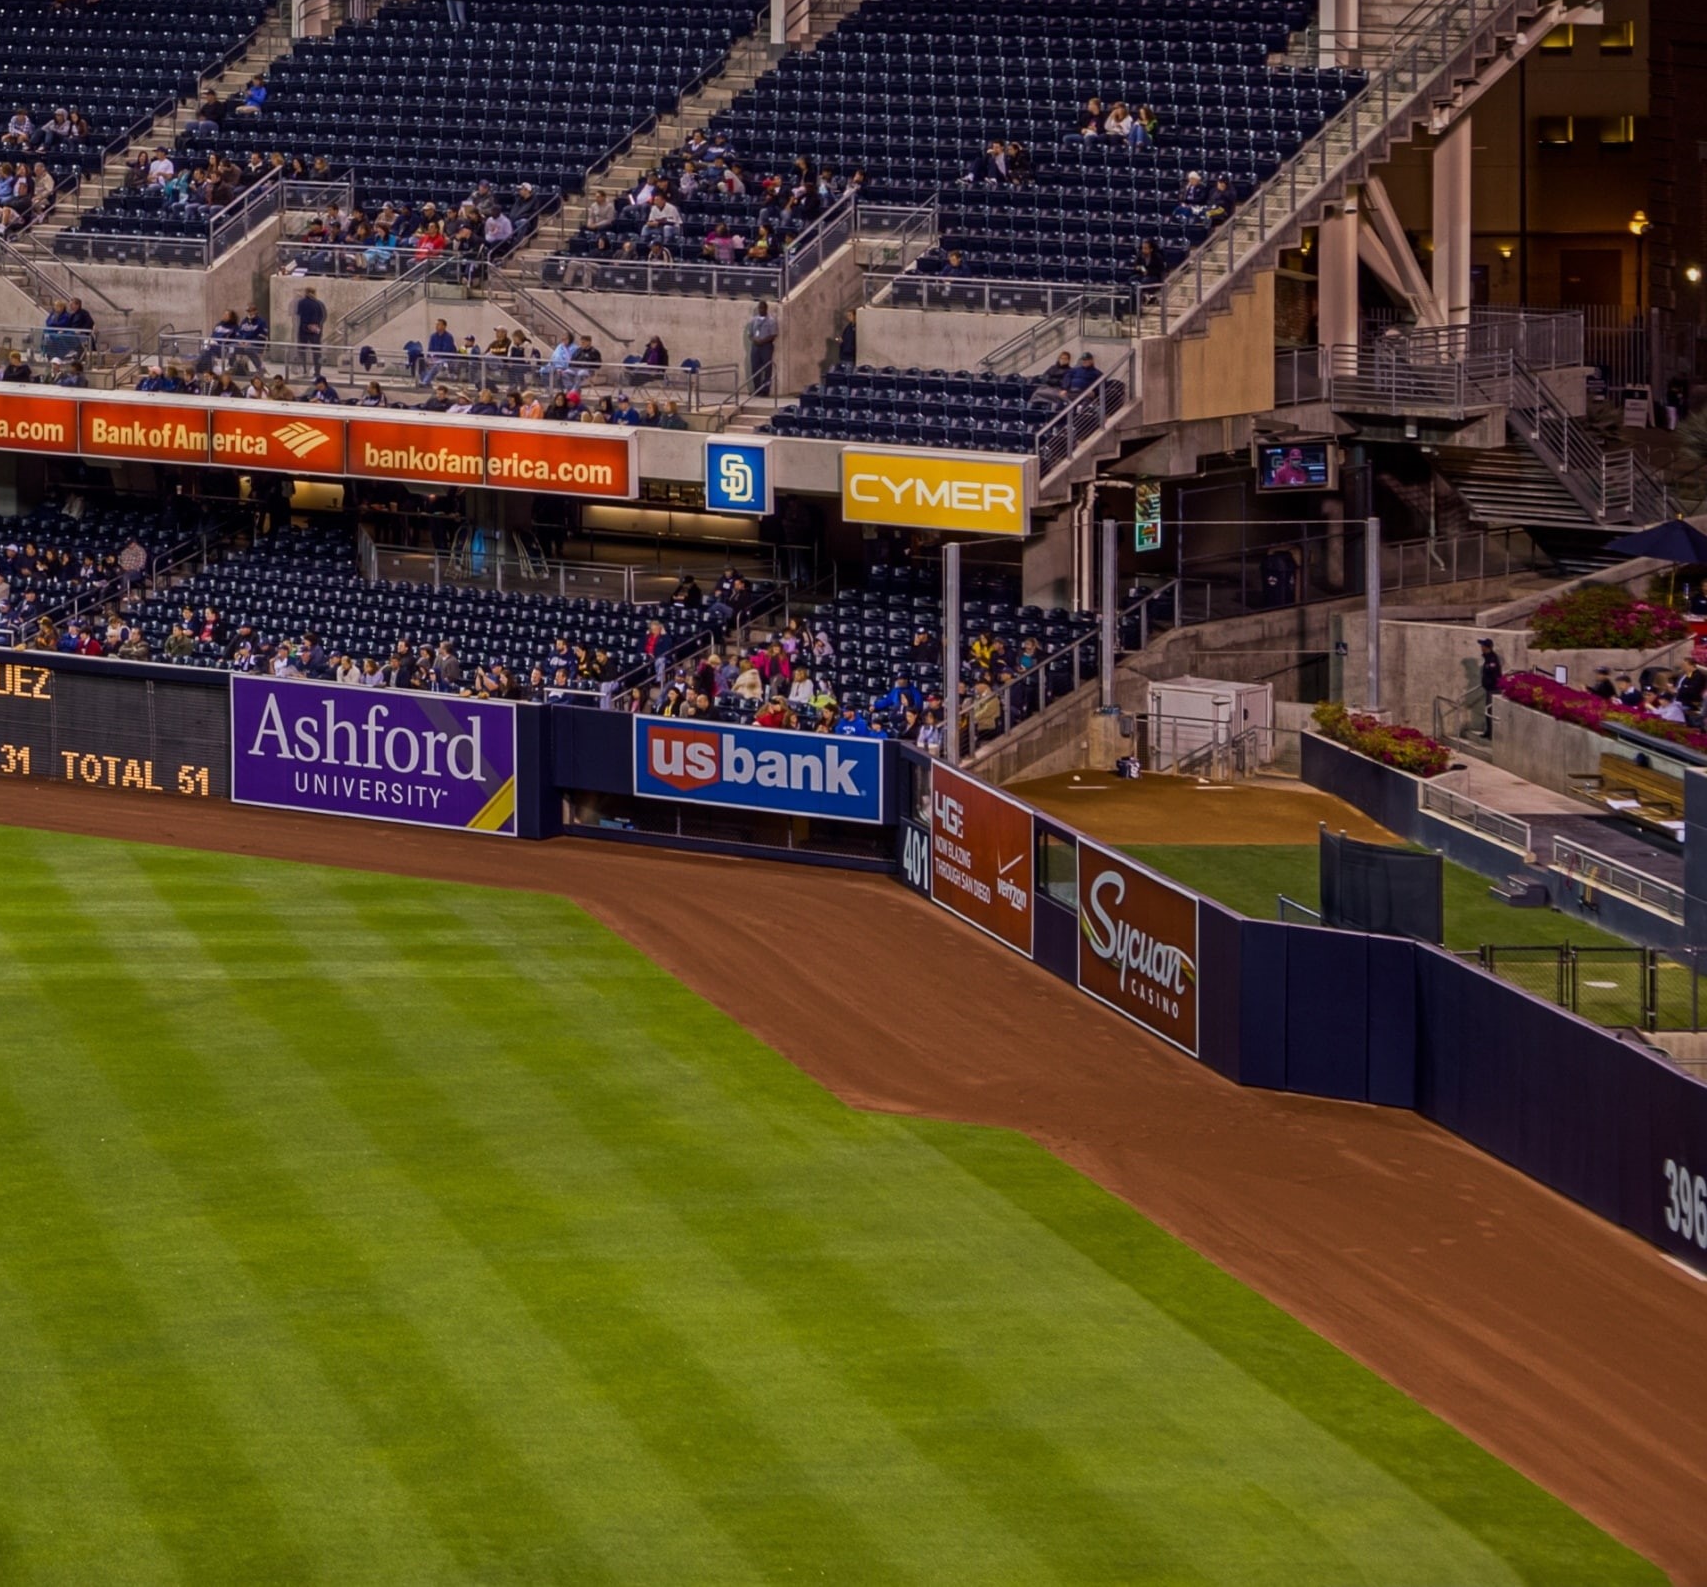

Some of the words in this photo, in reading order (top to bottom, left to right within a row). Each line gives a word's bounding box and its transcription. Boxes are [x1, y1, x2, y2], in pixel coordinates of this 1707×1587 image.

[92, 419, 146, 448] Bank
[149, 422, 170, 450] of
[172, 424, 266, 455] America
[365, 441, 611, 486] bankofamerica.com
[849, 475, 1016, 513] CYMER
[247, 691, 488, 784] Ashford
[0, 744, 30, 776] 31
[61, 751, 162, 791] TOTAL
[178, 766, 209, 796] 51
[294, 770, 442, 809] UNIVERSITY
[903, 827, 928, 890] 401
[935, 857, 960, 886] THROUGH
[962, 873, 973, 895] SAN
[974, 879, 990, 904] DIEGO
[997, 878, 1026, 911] verizon
[1090, 871, 1185, 995] Sycuan
[1131, 979, 1179, 1019] CASINO
[1664, 1158, 1707, 1249] 396
